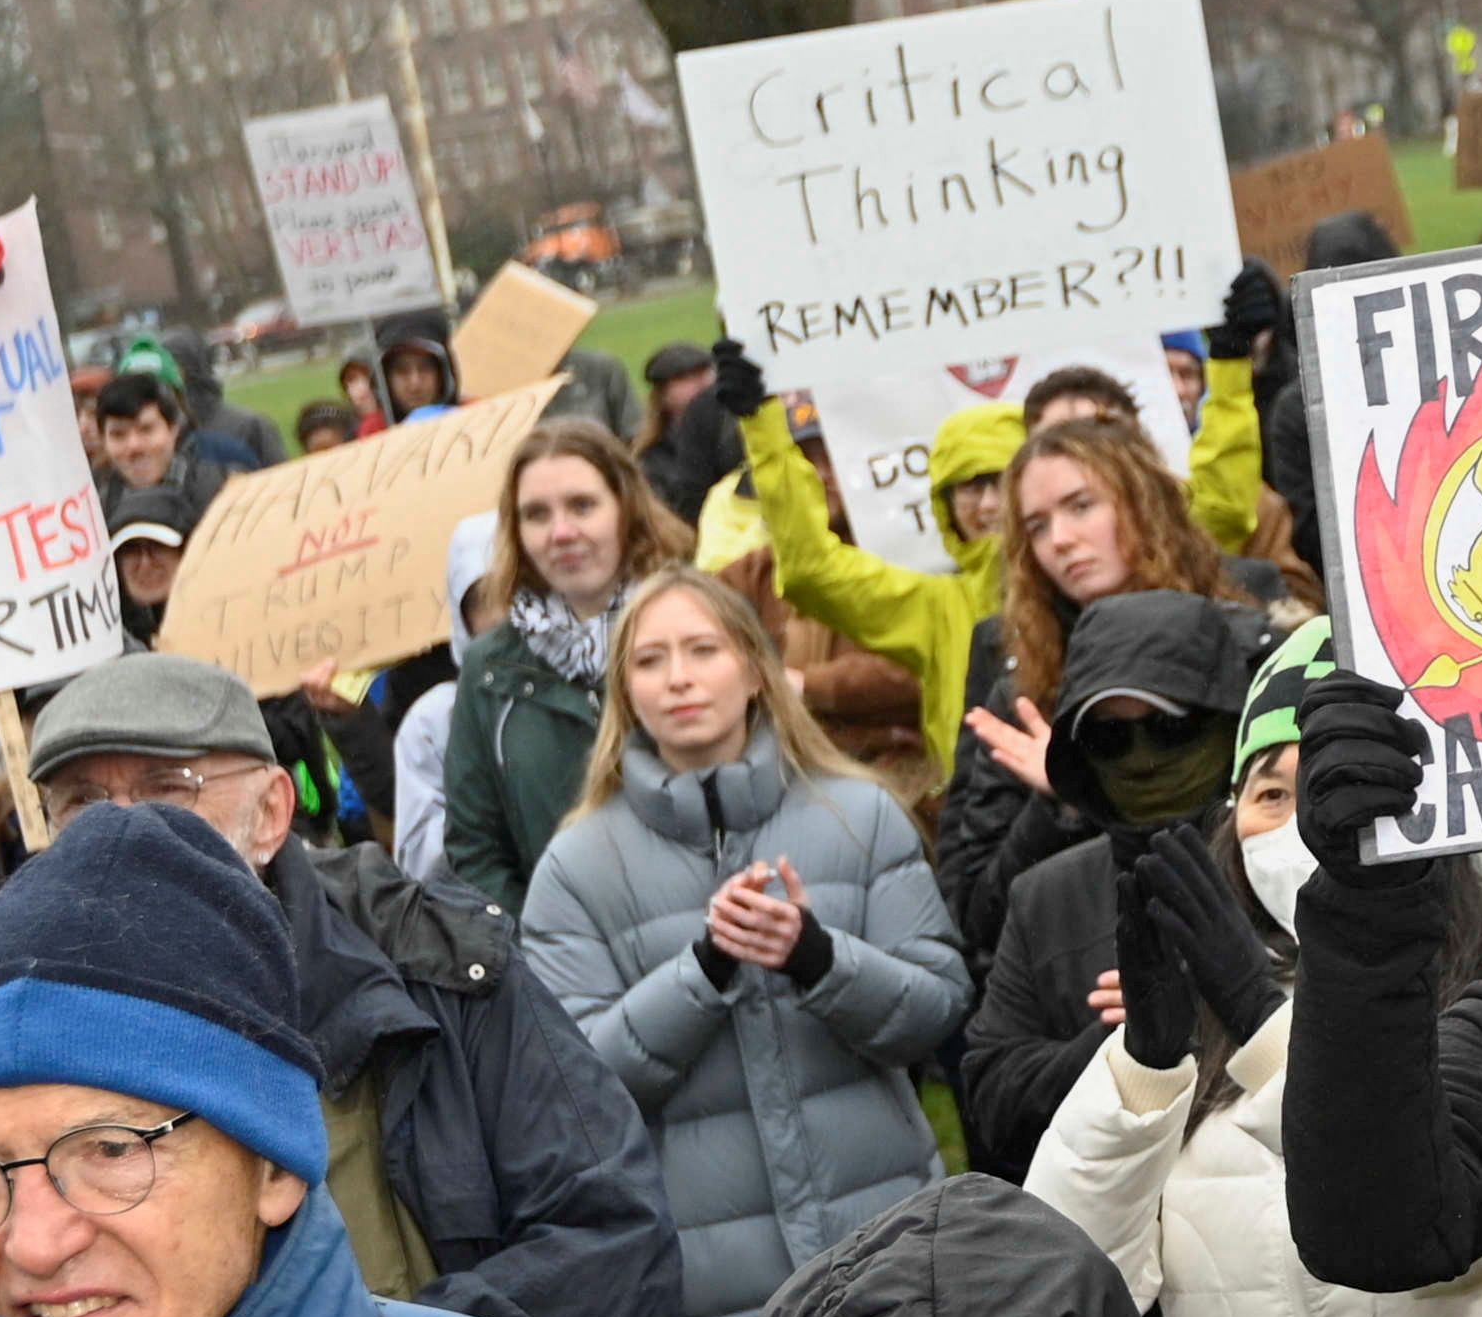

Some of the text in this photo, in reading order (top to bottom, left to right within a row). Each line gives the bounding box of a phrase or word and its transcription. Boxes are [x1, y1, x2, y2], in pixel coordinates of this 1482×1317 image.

[748, 7, 1124, 147] Critical
[265, 158, 360, 205] STAND
[758, 246, 1188, 354] REMEMBER?!!
[201, 536, 413, 637] TRUMP
[296, 509, 380, 568] NOT
